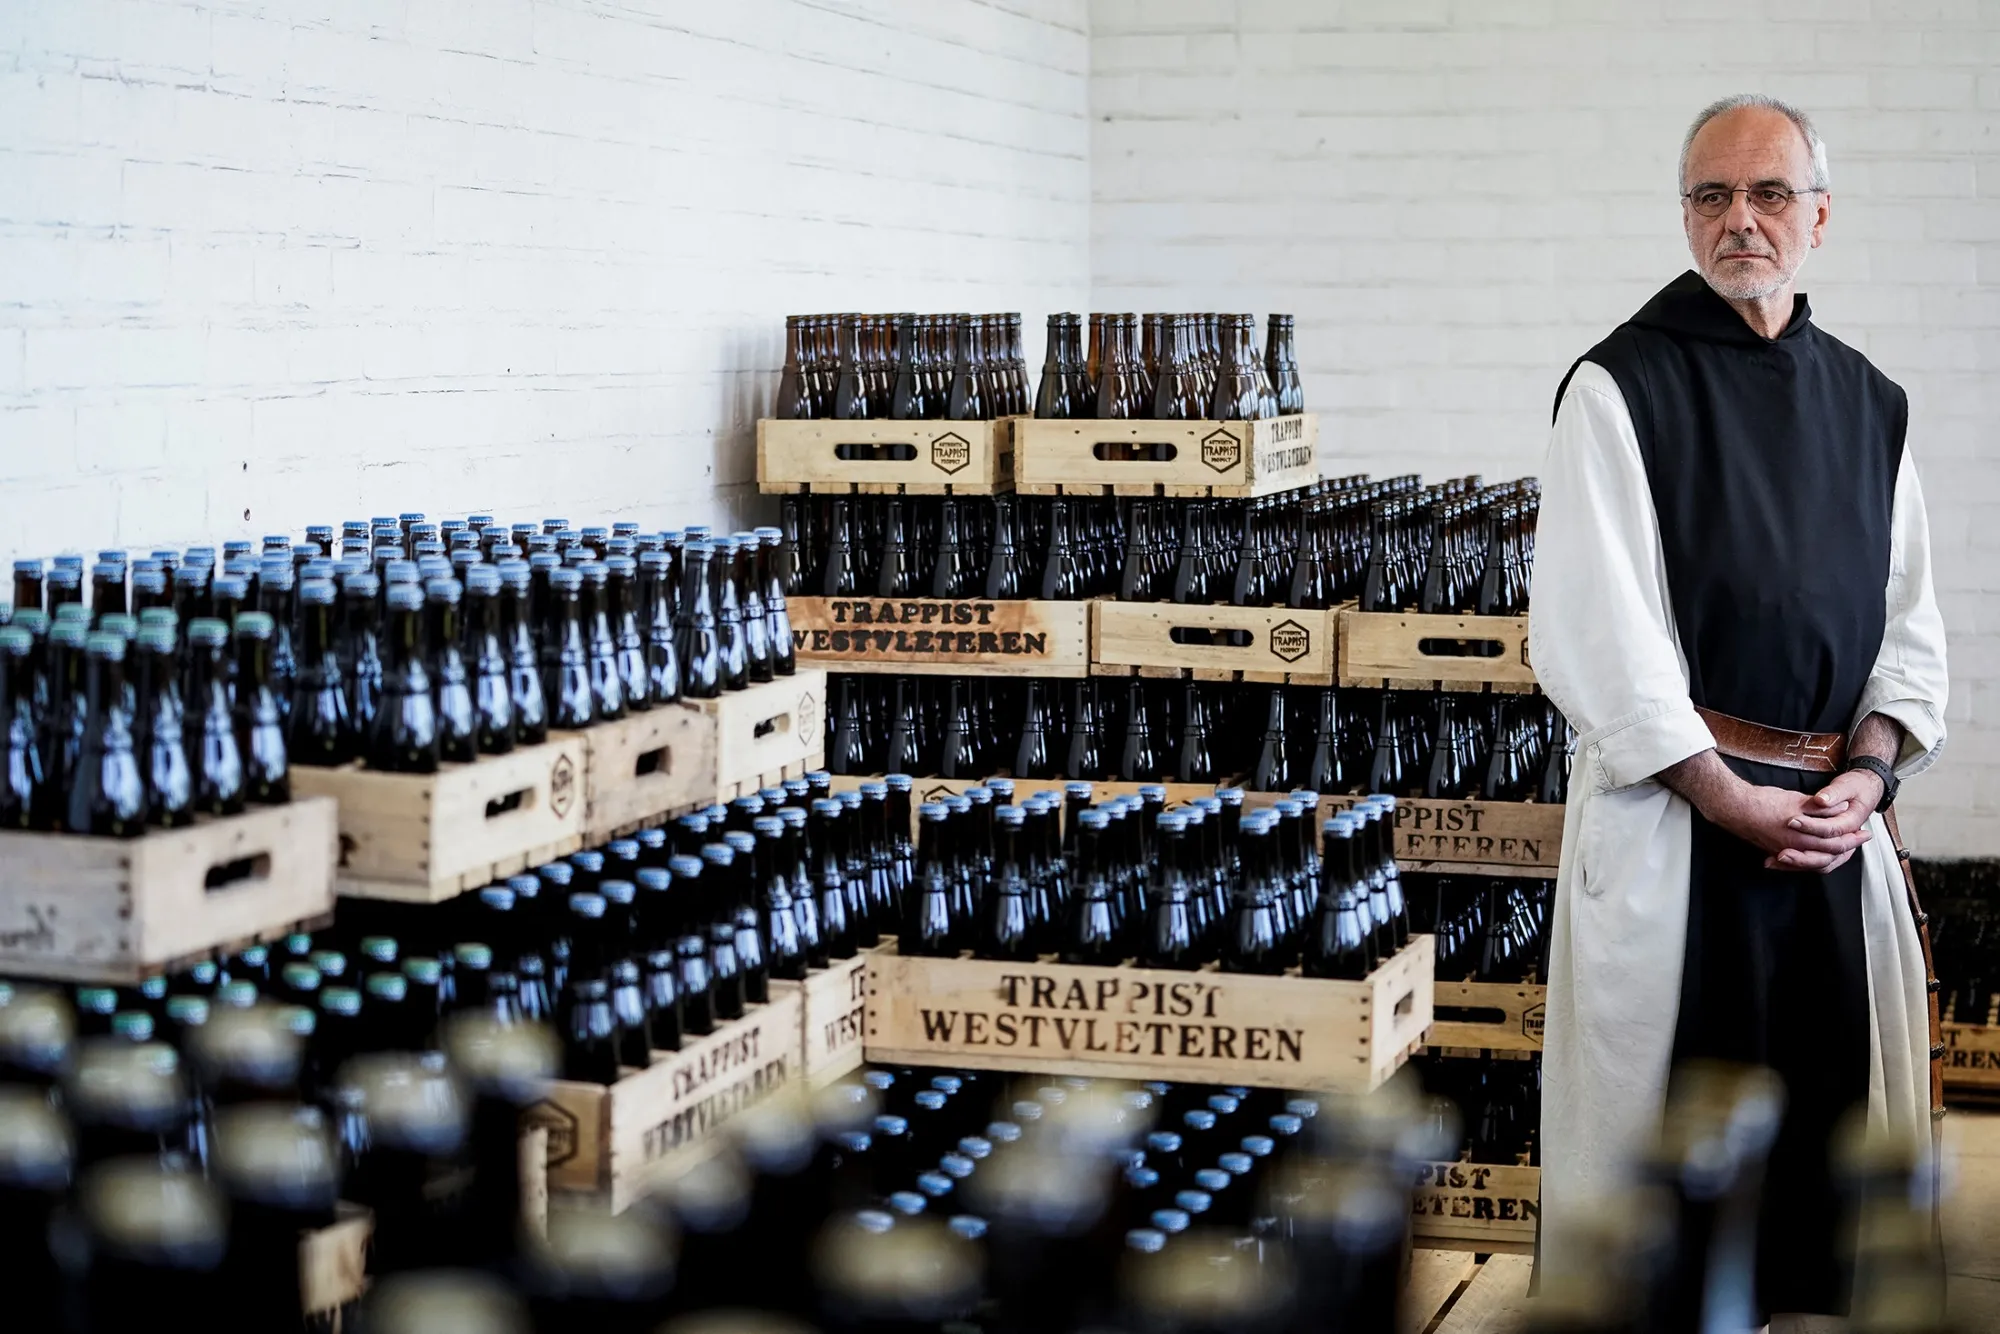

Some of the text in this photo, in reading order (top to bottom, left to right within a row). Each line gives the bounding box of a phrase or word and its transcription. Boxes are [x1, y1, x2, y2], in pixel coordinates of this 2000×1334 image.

[934, 448, 967, 458] TRAPPIST
[1204, 446, 1237, 456] TRAPPIST
[831, 602, 994, 625] TRAPPIST
[1273, 636, 1306, 646] TRAPPIST
[1001, 975, 1223, 1018] TRAPPIST
[920, 1009, 1304, 1062] WESTVLETEREN
